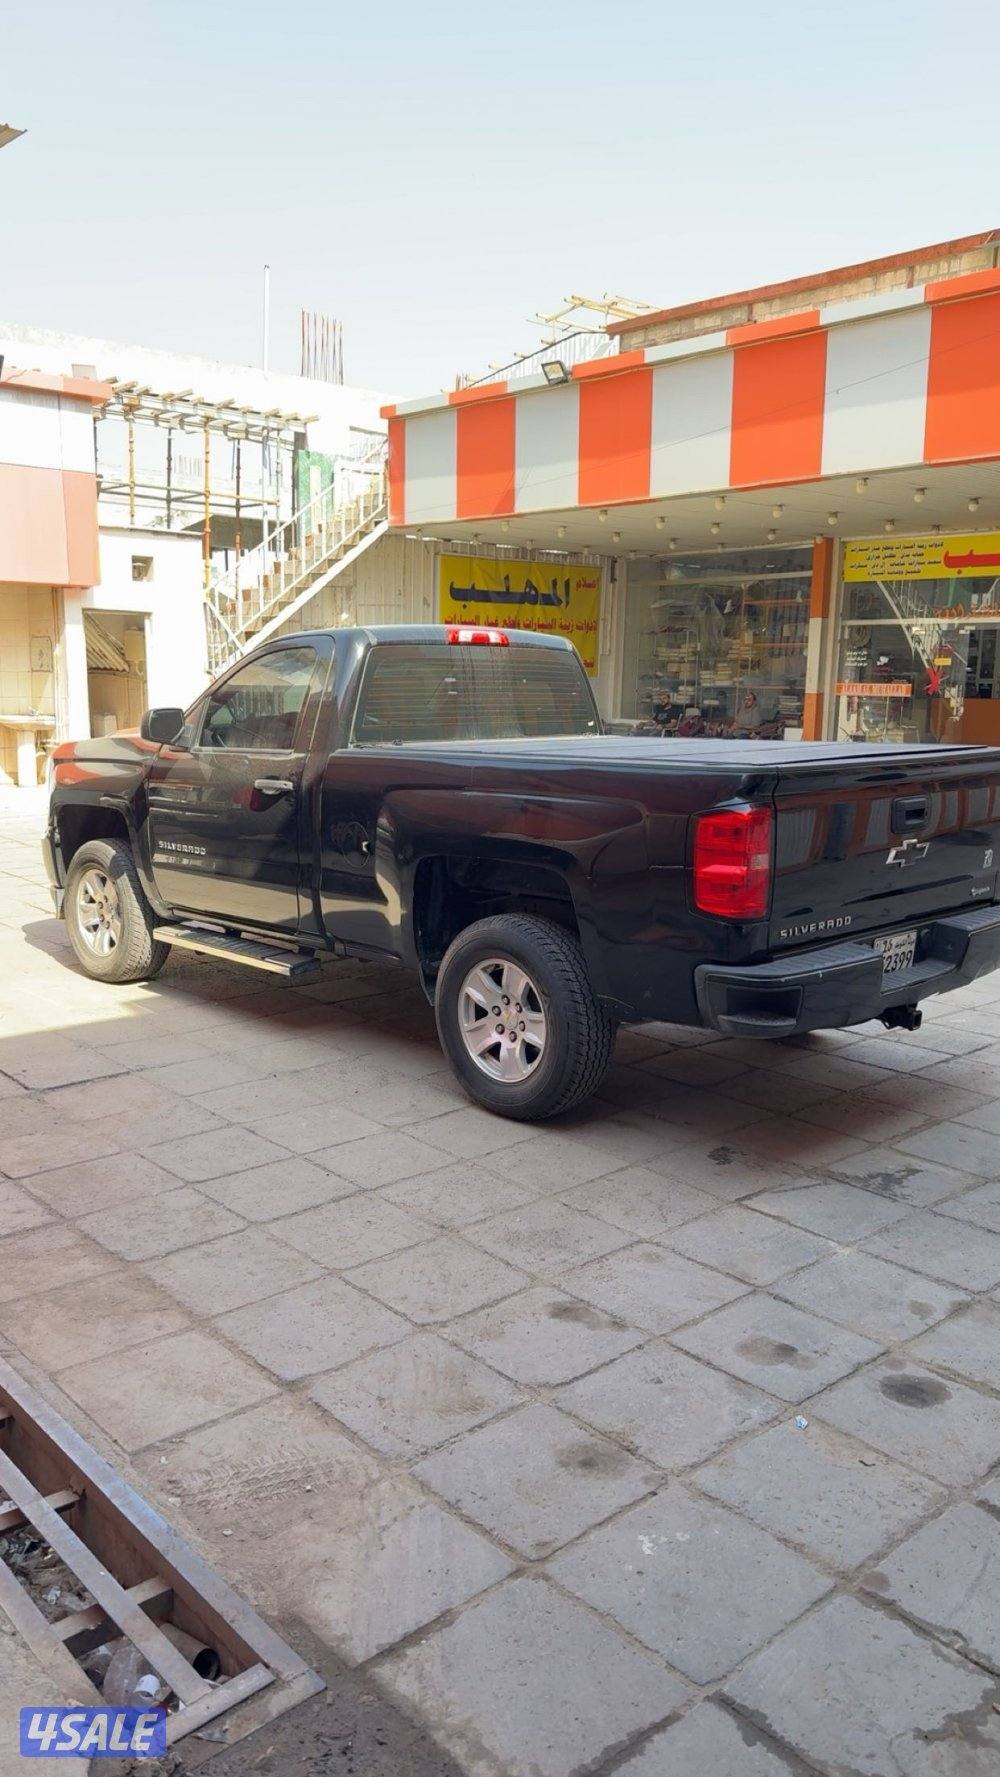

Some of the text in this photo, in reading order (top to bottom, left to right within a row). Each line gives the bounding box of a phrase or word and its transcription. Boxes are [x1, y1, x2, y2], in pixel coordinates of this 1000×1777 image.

[158, 840, 206, 855] SILVERADO
[780, 916, 852, 939] SILVERADO
[883, 949, 913, 973] 2399
